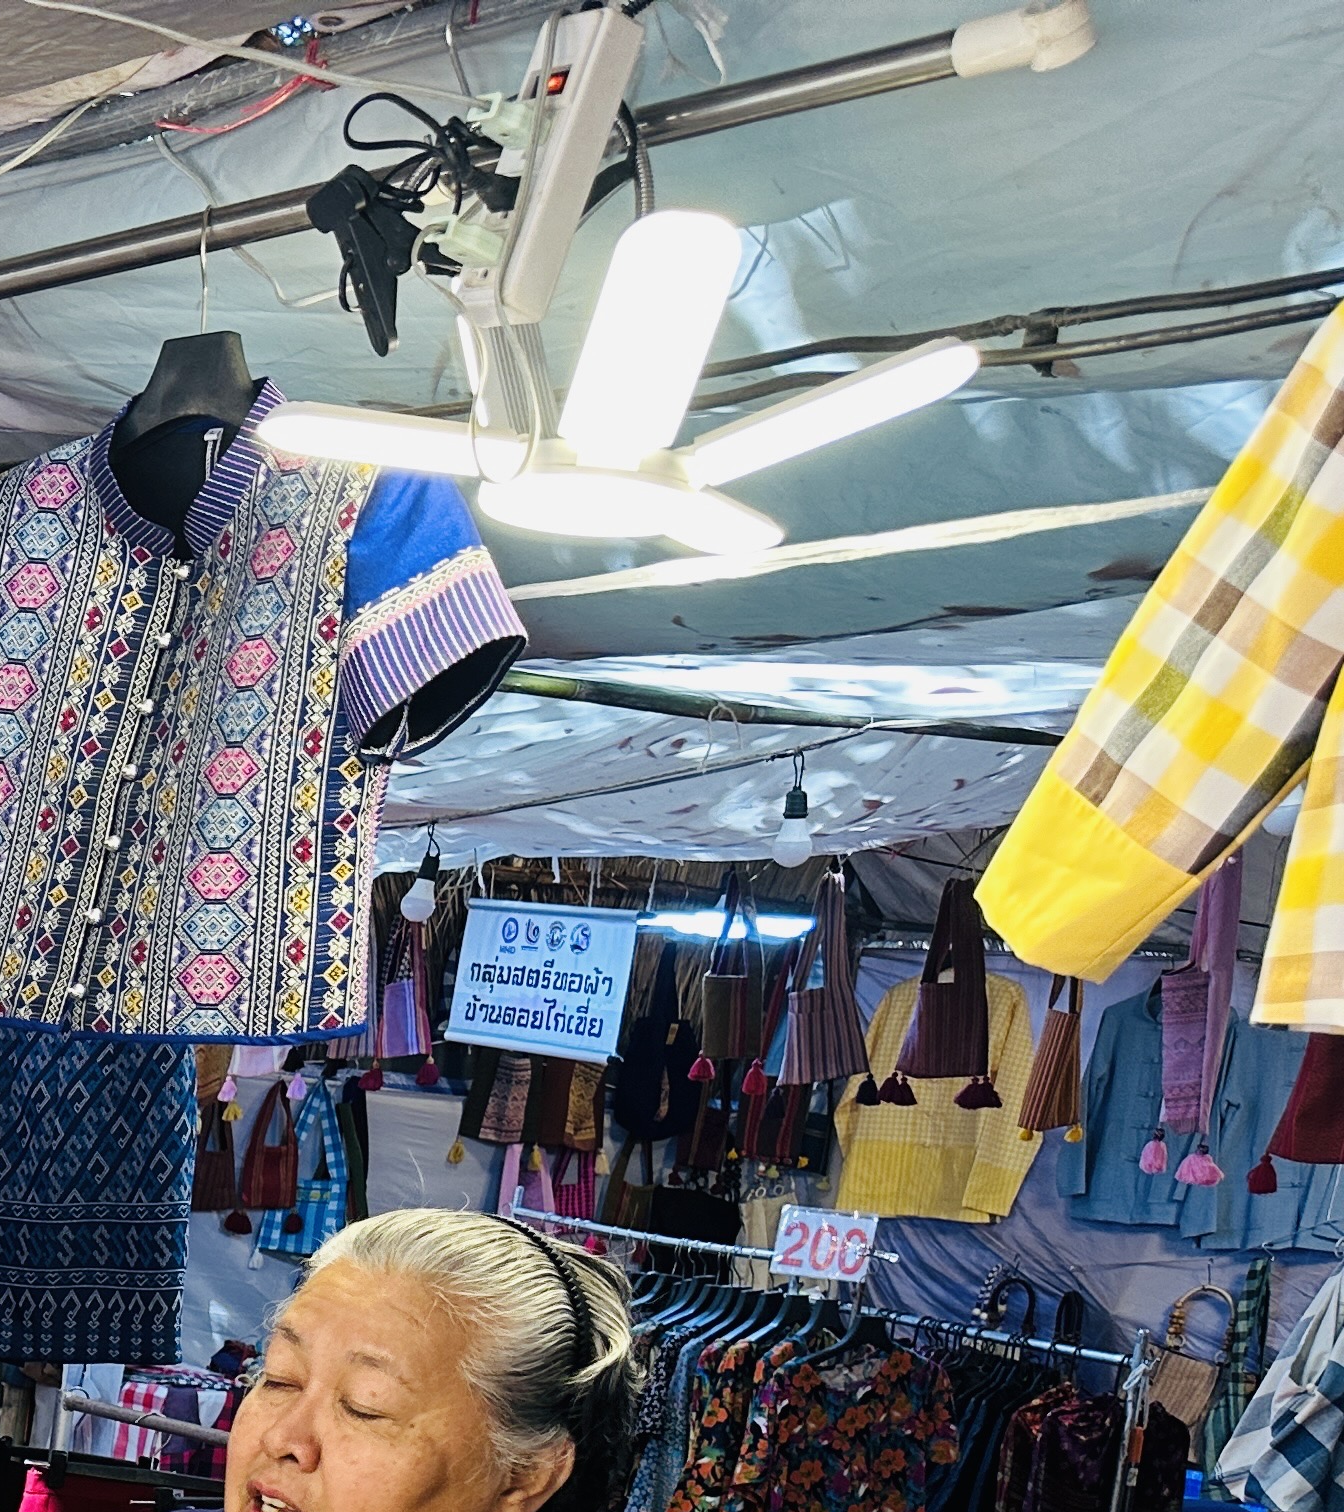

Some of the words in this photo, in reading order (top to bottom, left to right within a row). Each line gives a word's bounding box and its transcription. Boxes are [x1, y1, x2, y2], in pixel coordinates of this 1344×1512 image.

[470, 955, 613, 997] กลุ่มสตรีทอผ้า
[464, 995, 604, 1038] บ้านดอยไก่เขี่ย
[779, 1221, 869, 1275] 200
